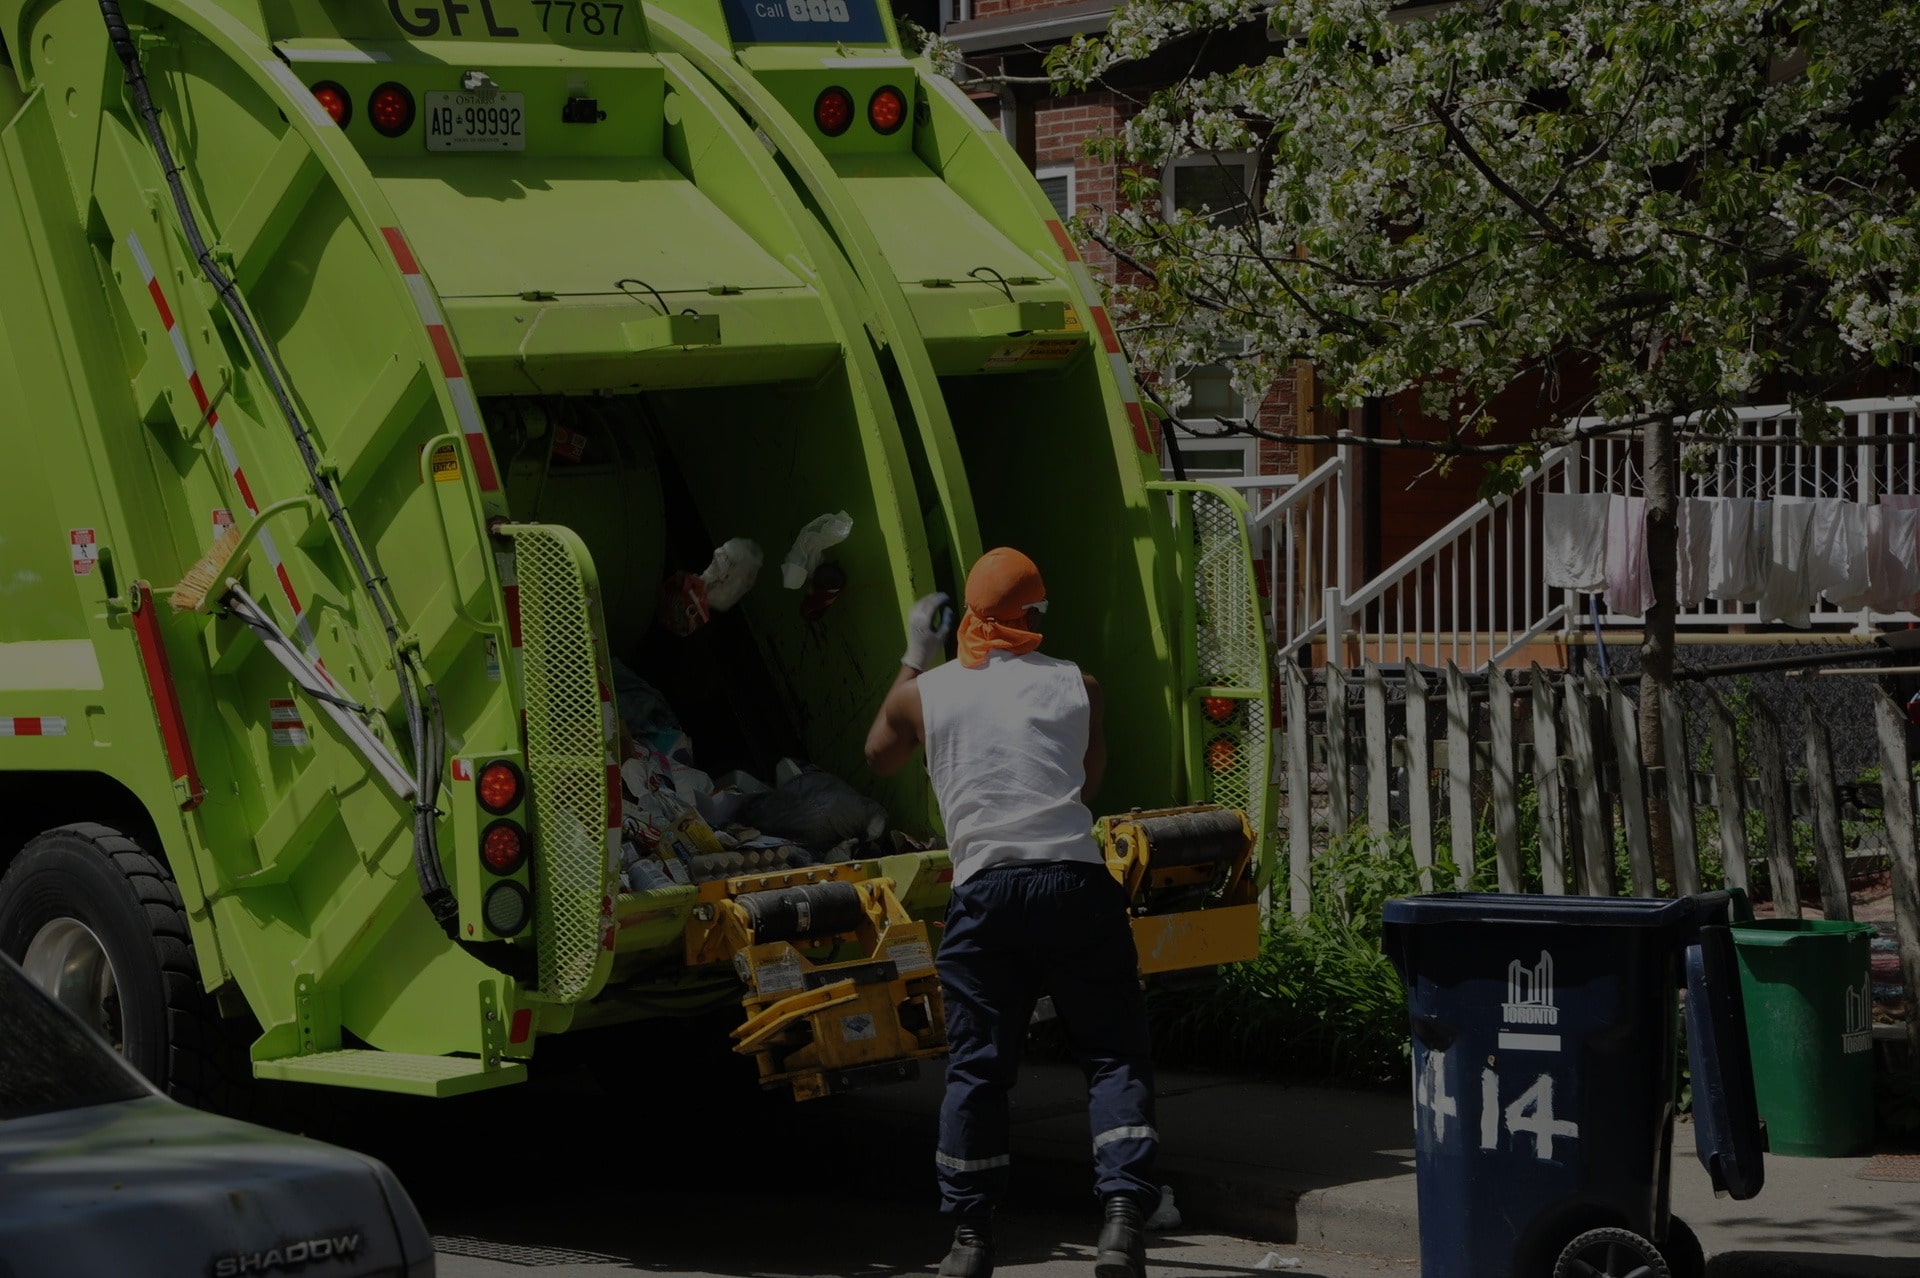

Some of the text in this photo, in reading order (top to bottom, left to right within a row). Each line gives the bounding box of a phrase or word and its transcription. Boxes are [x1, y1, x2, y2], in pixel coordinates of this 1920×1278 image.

[389, 0, 519, 36] GFL
[531, 0, 624, 35] 7787
[755, 3, 785, 17] Call
[432, 107, 521, 135] AB 99992
[1502, 1003, 1558, 1025] TORONTO
[1842, 1033, 1872, 1053] TORONT
[1480, 1066, 1579, 1160] 14
[215, 1234, 359, 1277] SHADOW
